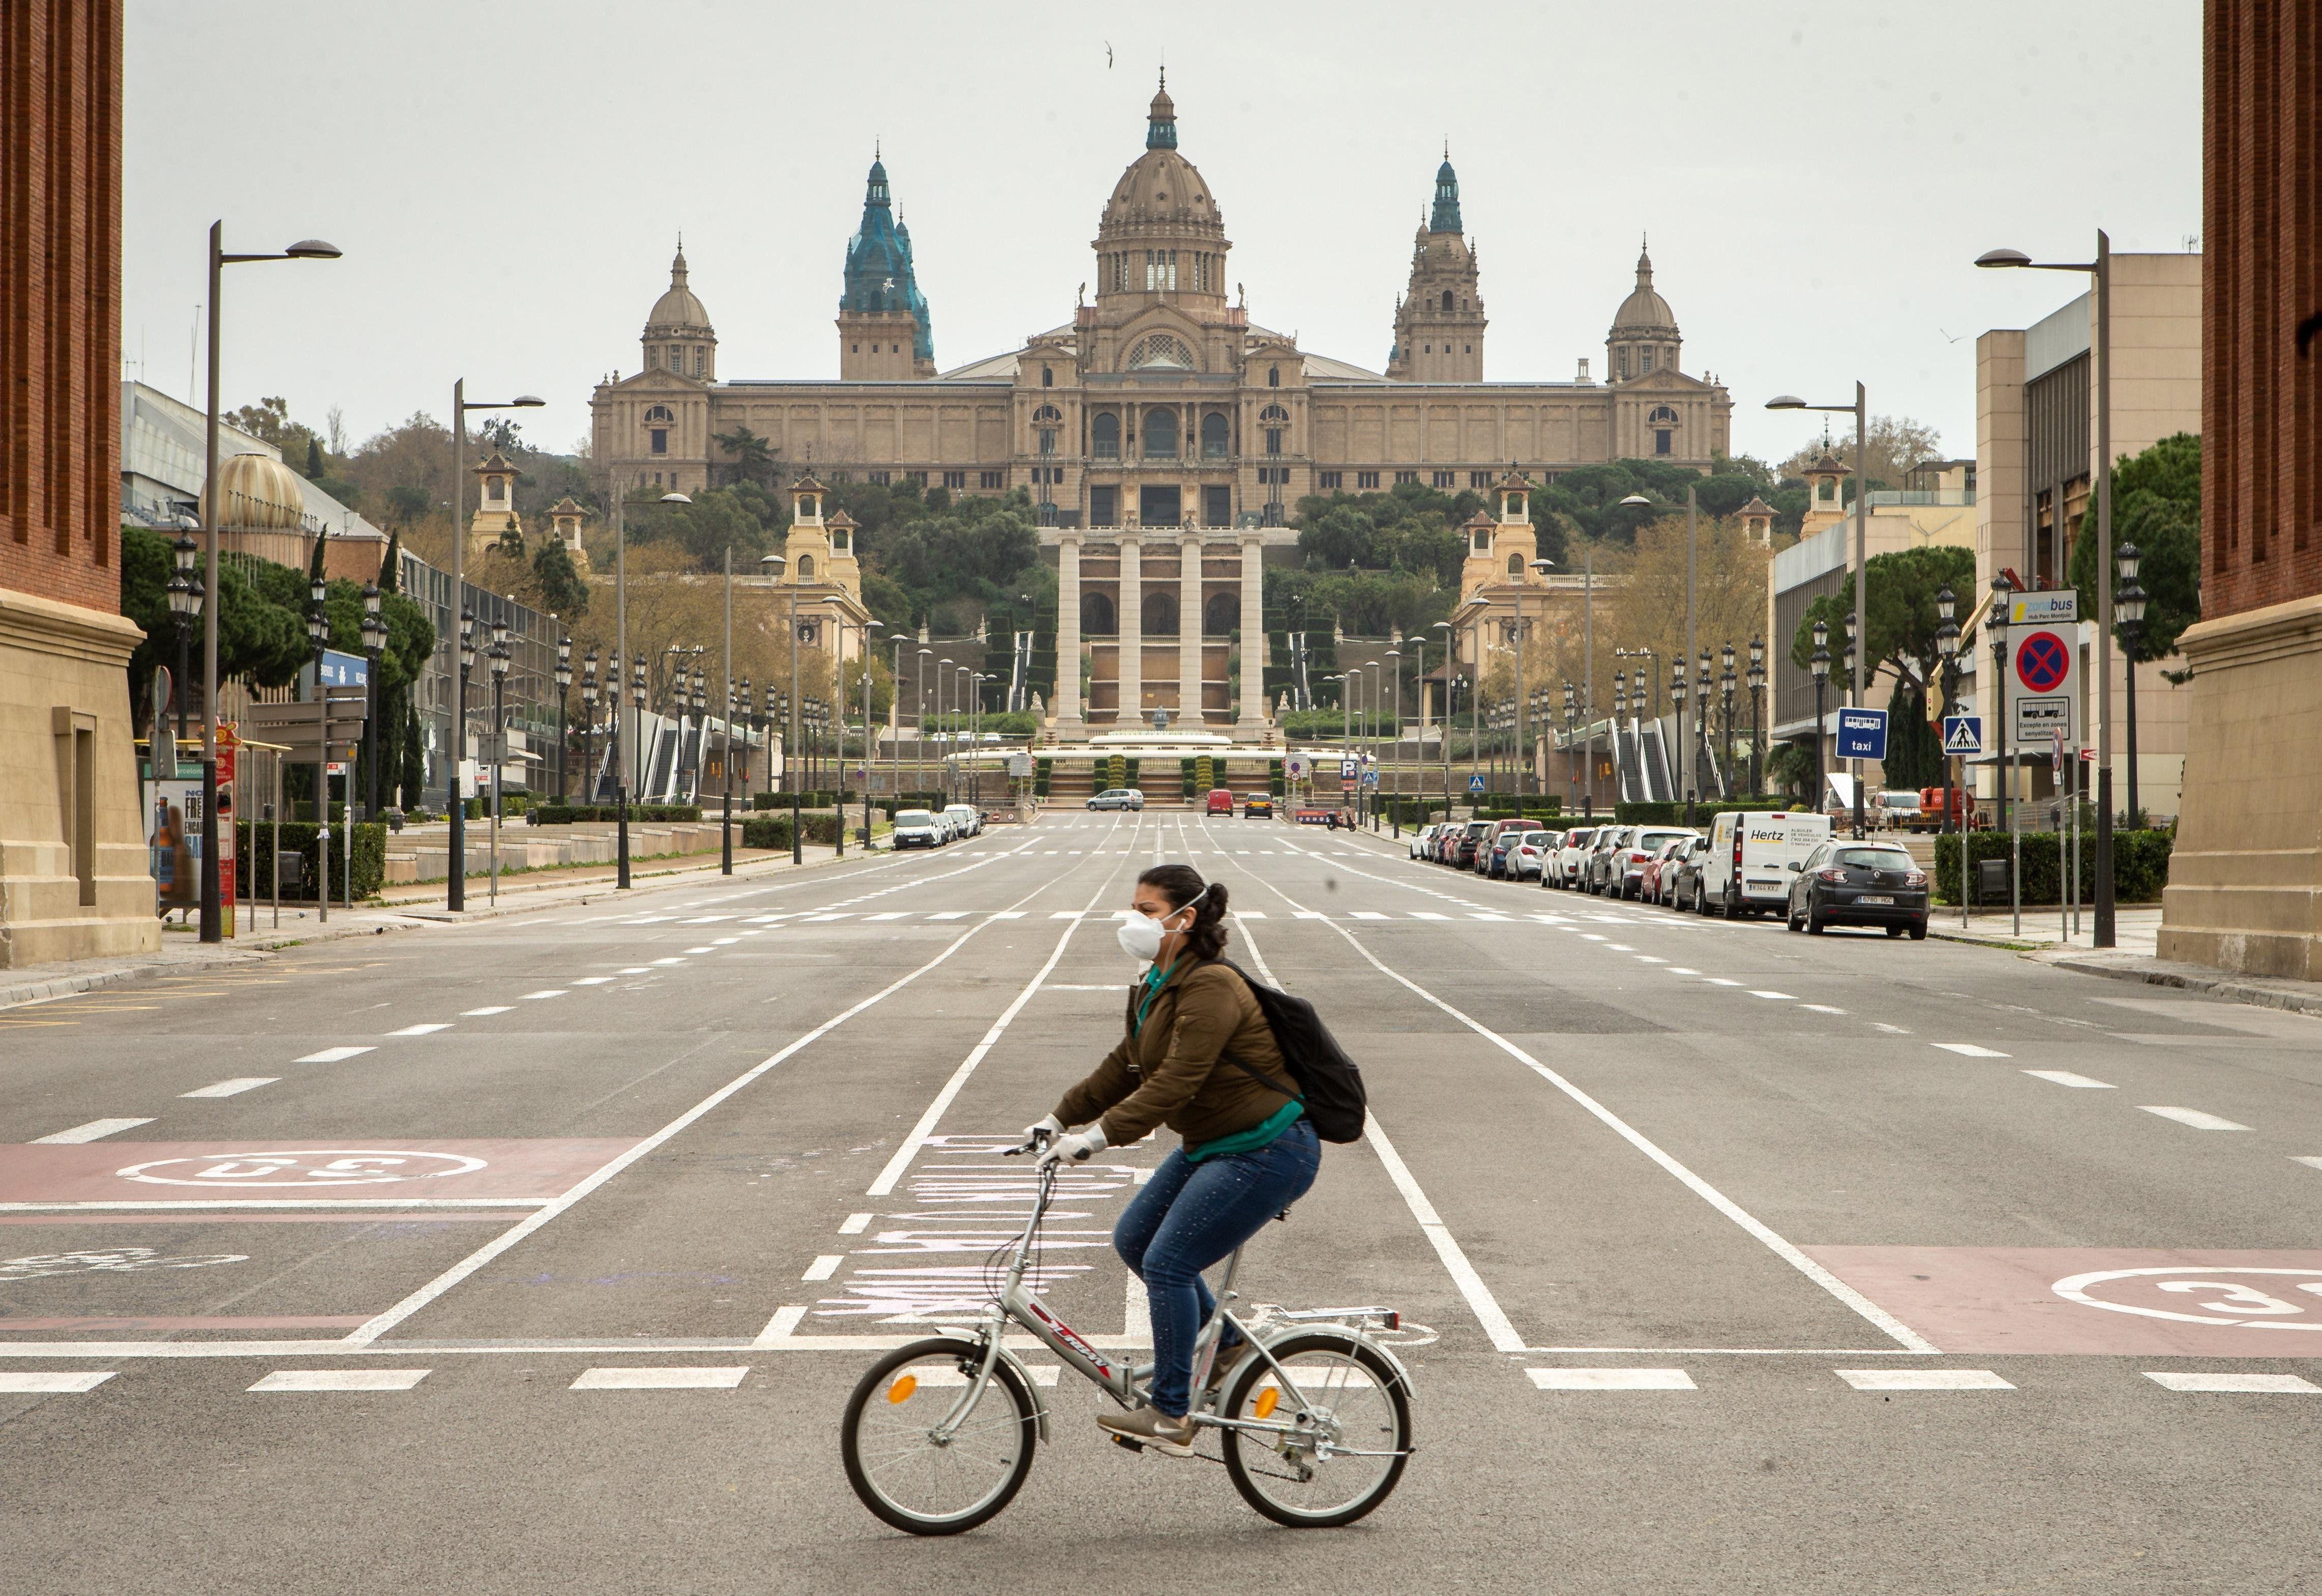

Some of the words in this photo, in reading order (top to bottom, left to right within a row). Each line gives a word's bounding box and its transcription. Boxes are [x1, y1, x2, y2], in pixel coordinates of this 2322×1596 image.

[2026, 598, 2073, 612] zonabus
[1852, 740, 1871, 751] taxi
[1343, 761, 1355, 776] P
[185, 797, 201, 819] FREE
[1750, 830, 1784, 841] Hertz
